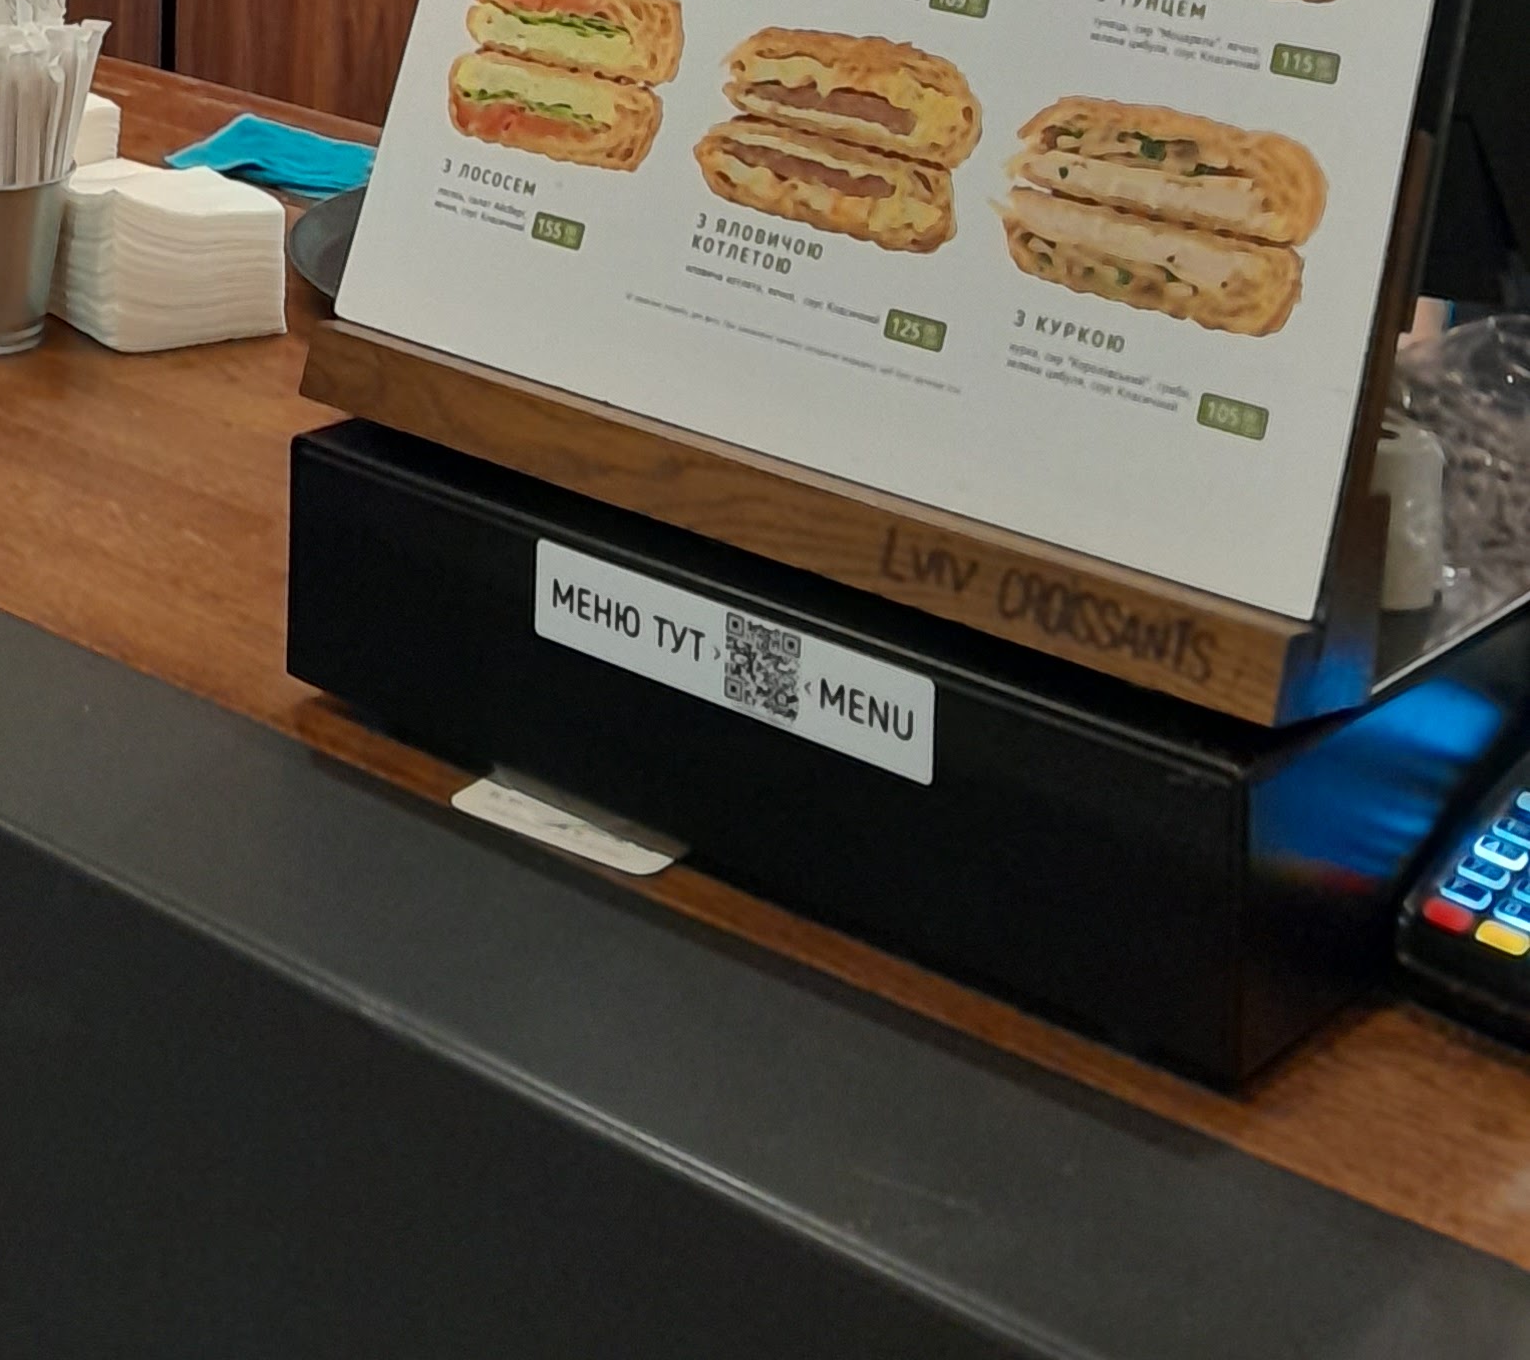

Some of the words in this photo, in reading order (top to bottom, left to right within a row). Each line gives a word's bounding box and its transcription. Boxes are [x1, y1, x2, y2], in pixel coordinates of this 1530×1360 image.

[1278, 50, 1315, 75] 115
[442, 157, 452, 174] З
[458, 163, 537, 197] ЛОСОСЕМ
[534, 217, 565, 240] 155
[696, 212, 707, 229] З
[715, 218, 824, 261] ЯЛОВИЧОЮ
[691, 234, 792, 275] КОТЛЕТОЮ
[888, 315, 923, 341] 125
[1013, 309, 1026, 328] З
[1035, 315, 1126, 354] КУРКОЮ
[551, 578, 642, 638] МЕНЮ
[653, 614, 705, 665] ТУТ
[996, 570, 1226, 685] CROISSANTS
[818, 676, 916, 744] MENU
